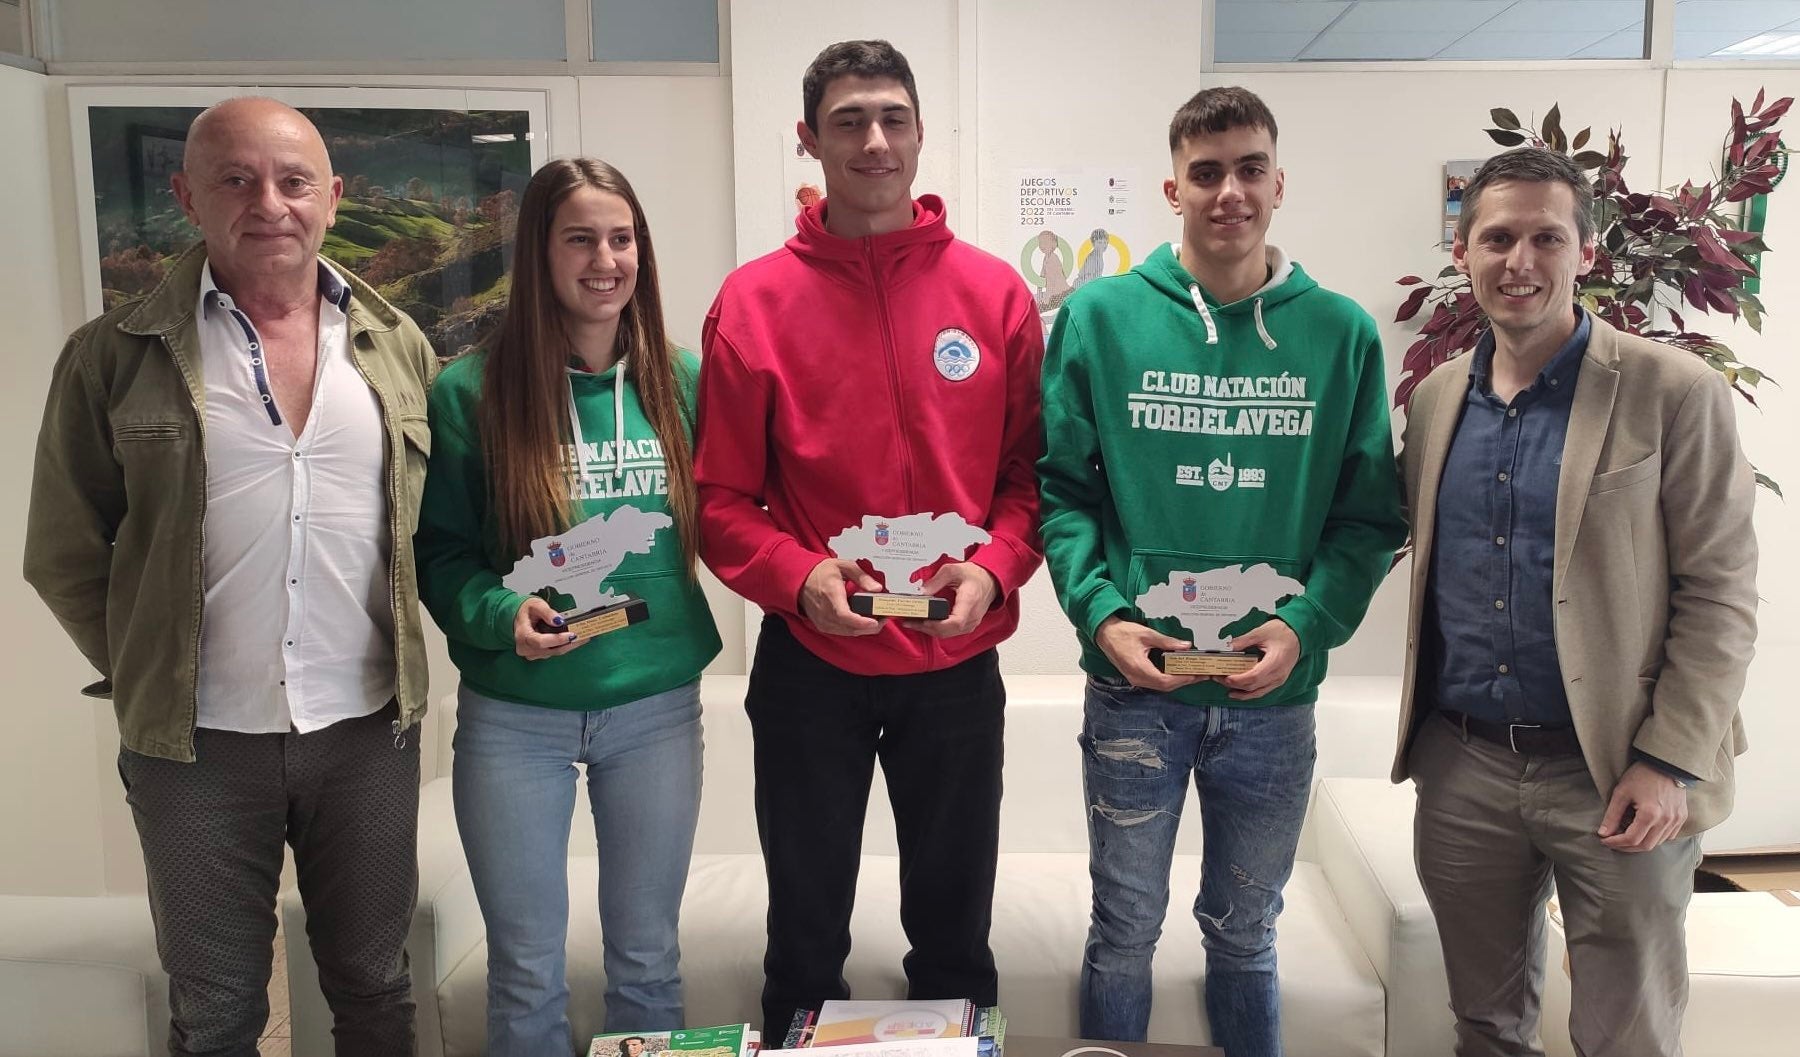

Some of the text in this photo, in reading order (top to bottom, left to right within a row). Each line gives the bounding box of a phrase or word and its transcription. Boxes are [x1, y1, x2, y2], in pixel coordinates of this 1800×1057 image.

[1020, 178, 1057, 187] JUEGOS
[1020, 188, 1078, 196] DEPORTIVOS
[1020, 197, 1071, 206] ESCOLARES
[1020, 207, 1045, 216] 2022
[1020, 217, 1045, 226] 2023
[1142, 370, 1307, 398] CLUB NATACIÓN
[1128, 402, 1313, 436] TORRELAVEGA
[1176, 465, 1204, 480] EST.
